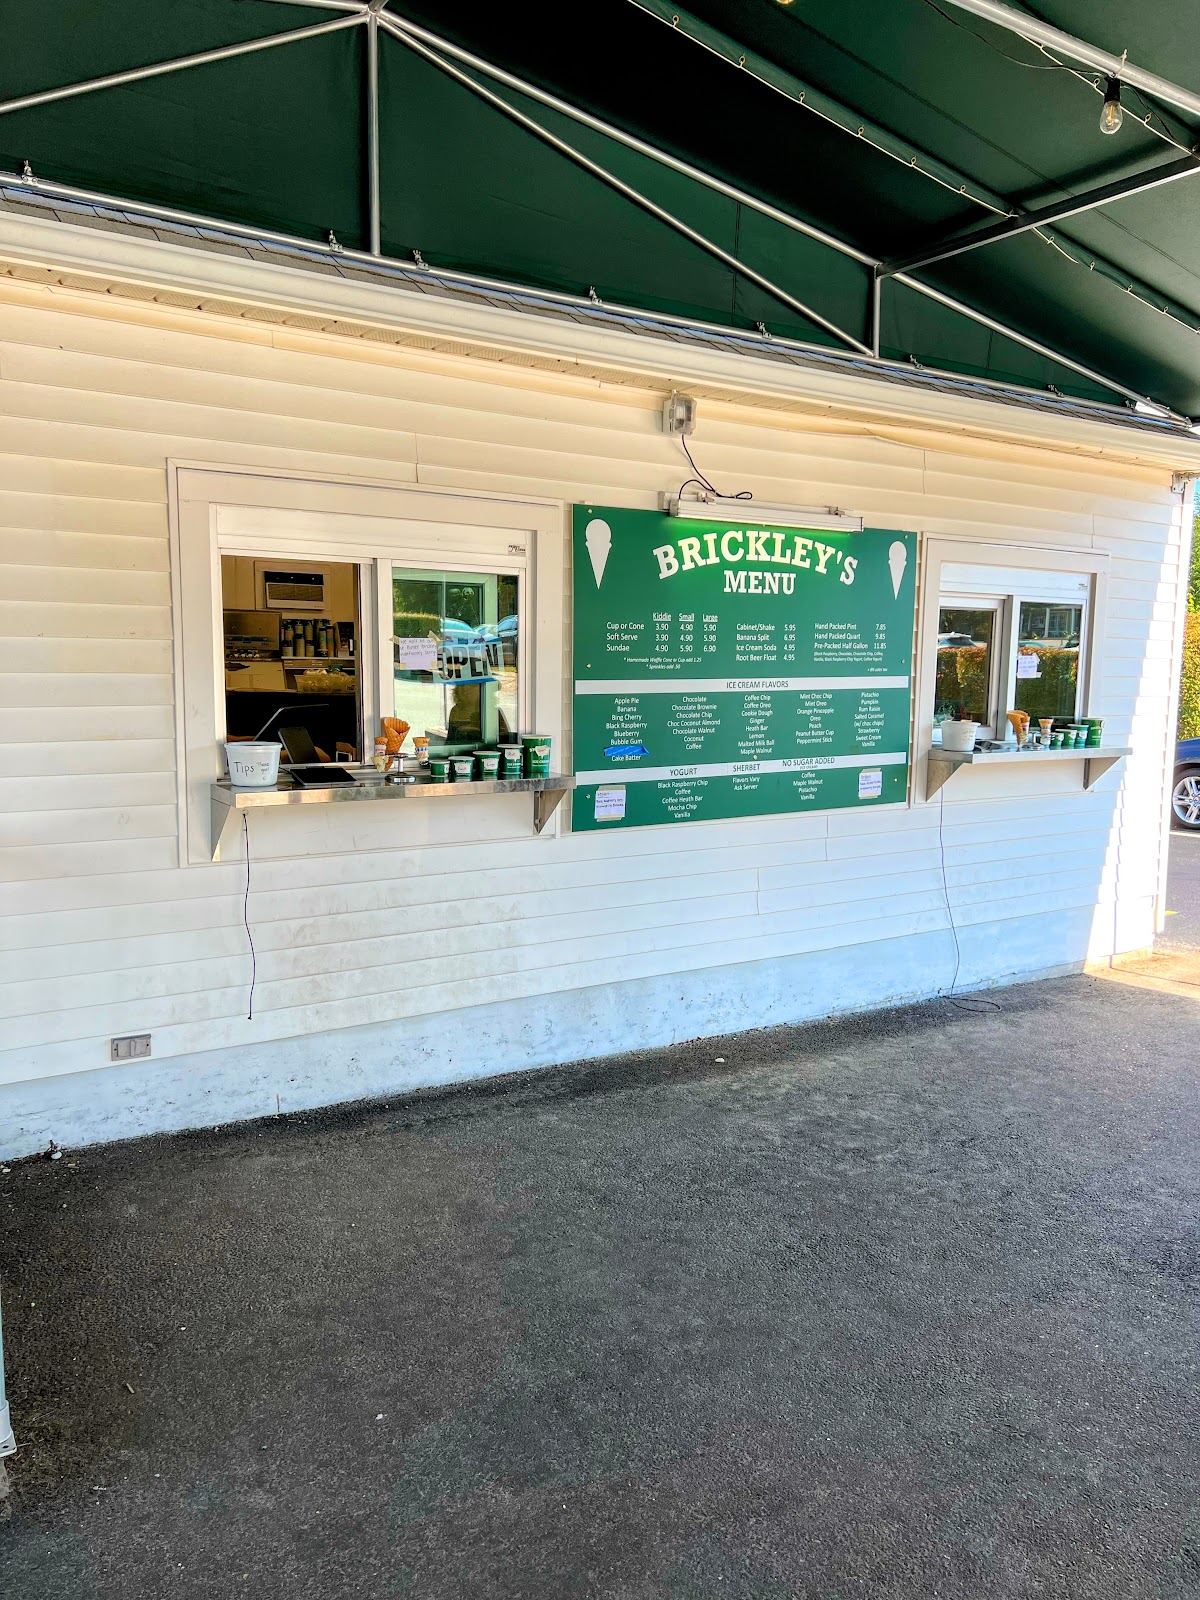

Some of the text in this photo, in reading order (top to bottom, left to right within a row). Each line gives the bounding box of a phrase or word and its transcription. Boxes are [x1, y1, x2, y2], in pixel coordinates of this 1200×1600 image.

[653, 530, 858, 585] BRICKLEY'S
[724, 570, 796, 594] MENU
[653, 613, 718, 622] Kiddie Small Large
[607, 622, 619, 630] Cup
[737, 623, 775, 631] Cabinet/Shake
[758, 634, 769, 642] Split
[437, 644, 499, 680] OPEN
[234, 762, 254, 777] Tips
[670, 768, 697, 776] YOGURT
